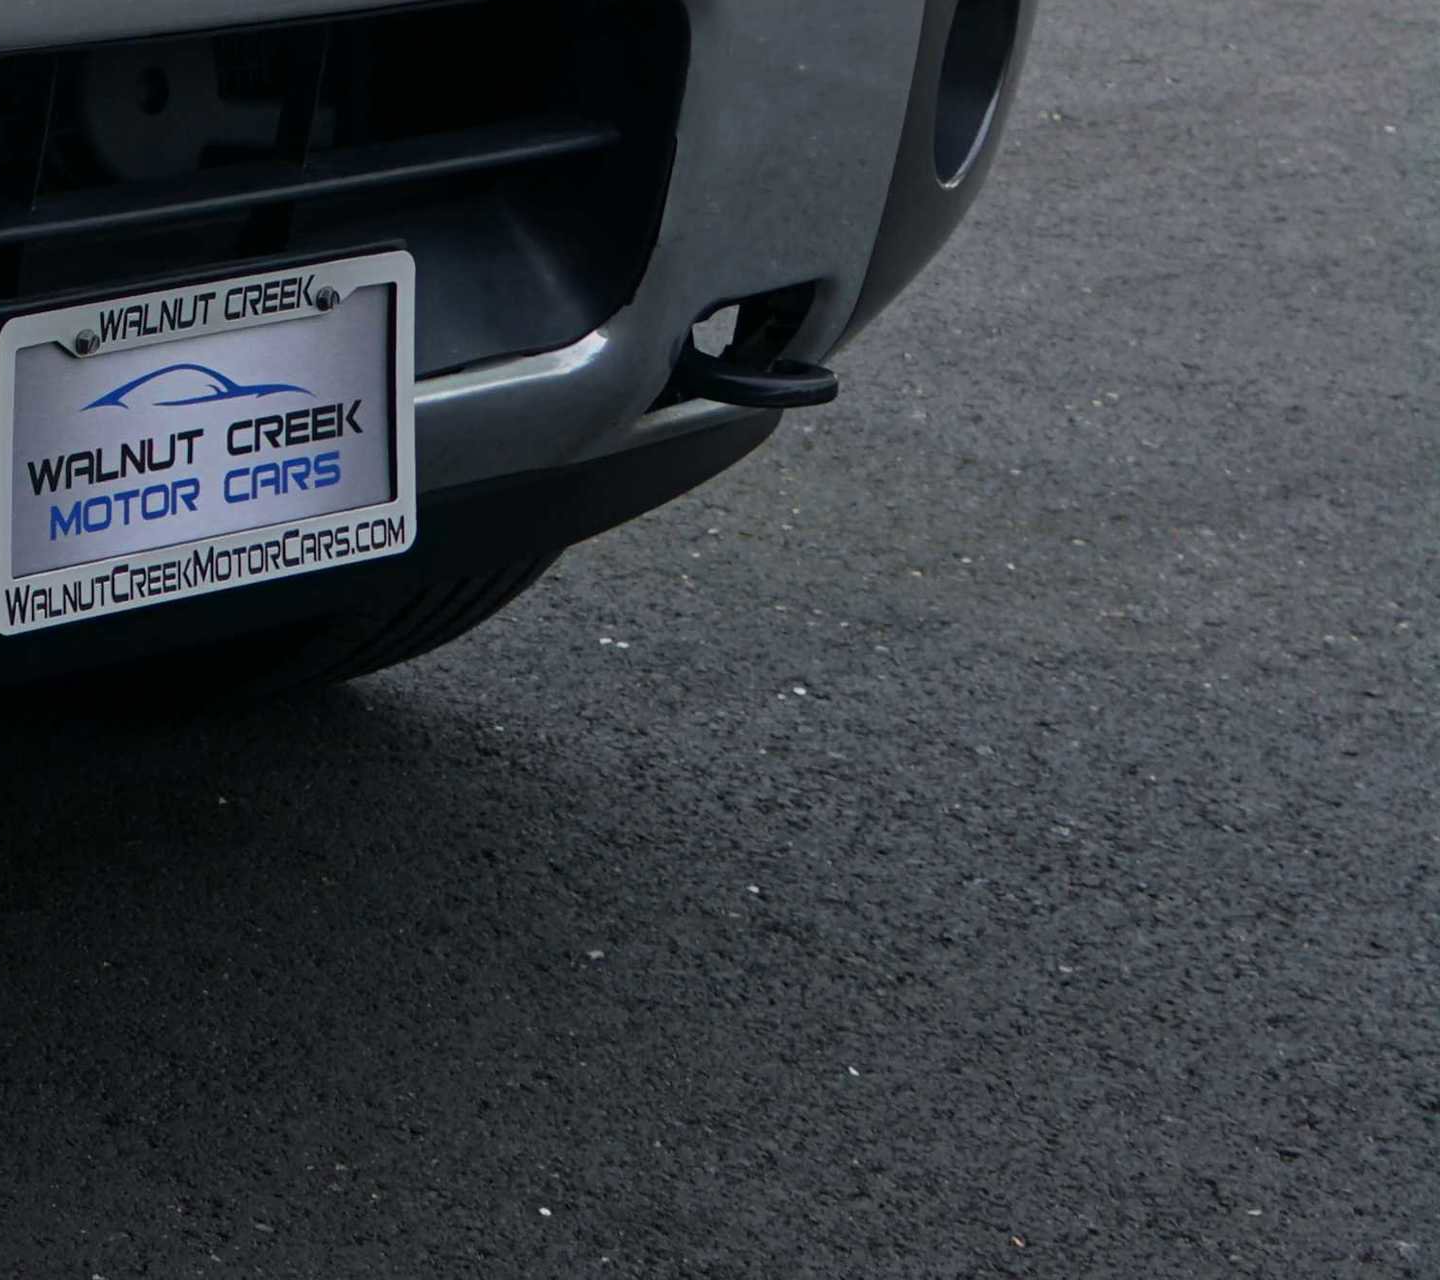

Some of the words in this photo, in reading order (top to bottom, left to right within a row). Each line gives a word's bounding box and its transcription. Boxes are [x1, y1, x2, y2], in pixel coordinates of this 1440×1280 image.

[99, 292, 216, 343] WALNUT
[224, 274, 315, 321] CREEK
[28, 429, 204, 496] WALNUT
[227, 399, 363, 456] CREEK
[49, 477, 200, 540] MOTOR
[224, 451, 341, 503] CARS
